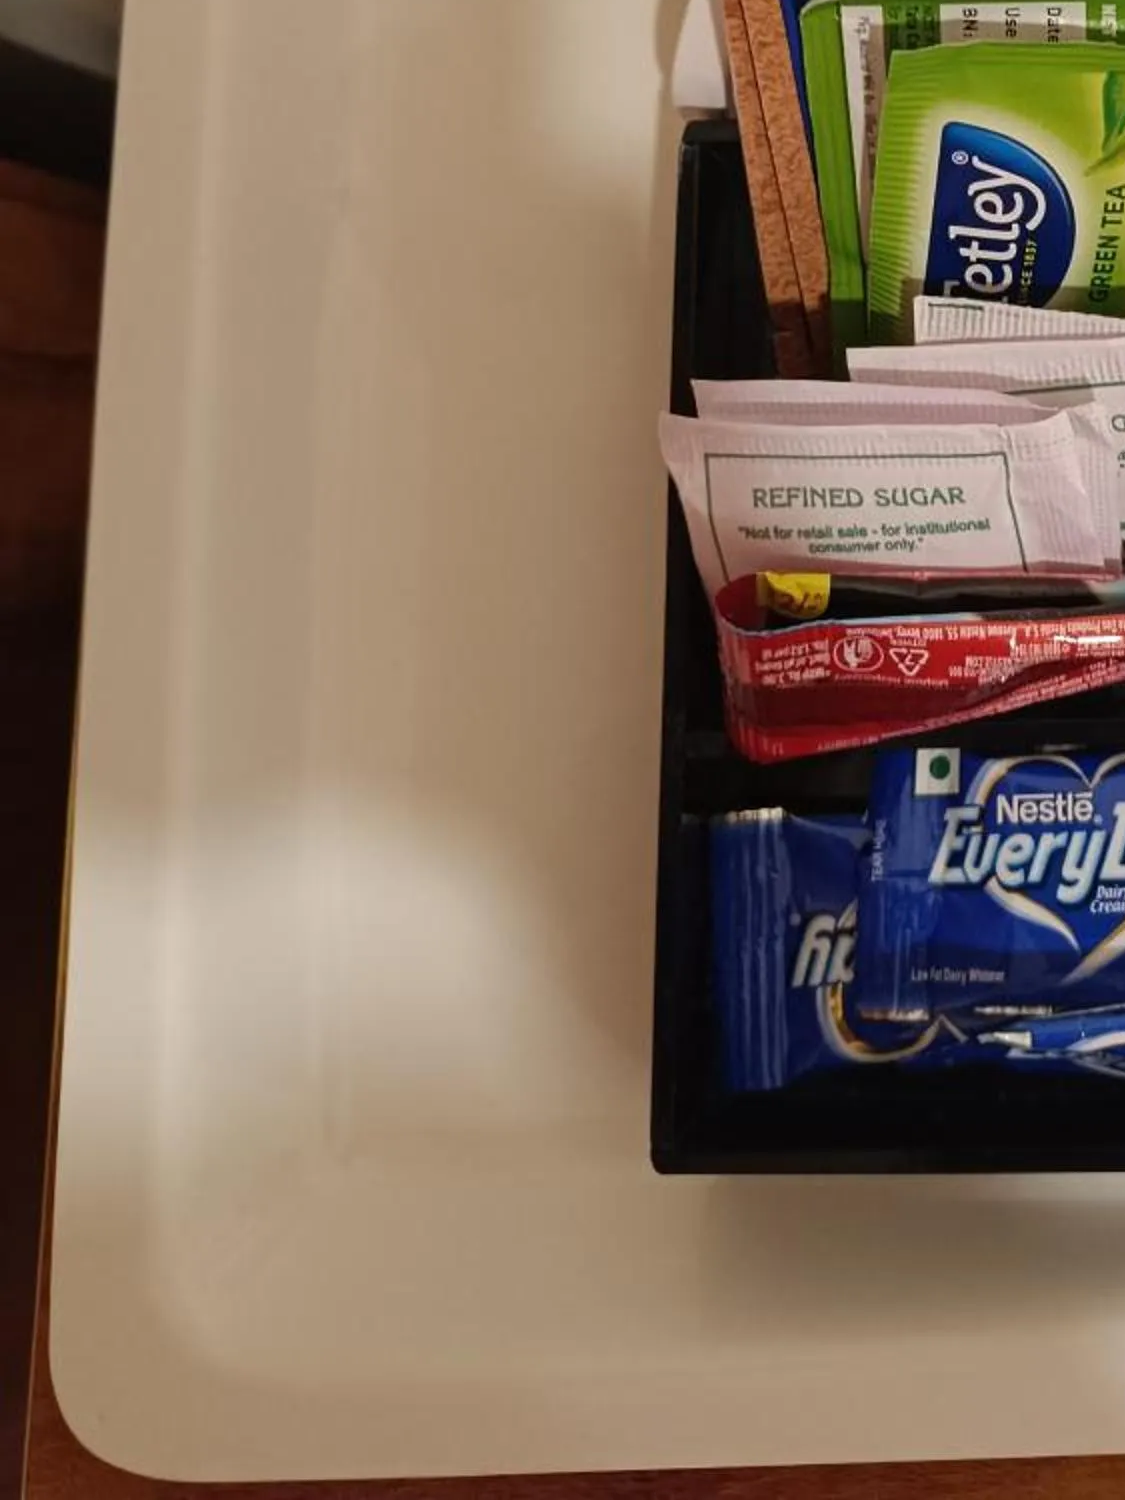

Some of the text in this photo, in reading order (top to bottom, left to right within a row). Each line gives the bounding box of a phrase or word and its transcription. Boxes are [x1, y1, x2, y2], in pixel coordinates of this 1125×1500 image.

[1005, 7, 1020, 37] Use
[1089, 235, 1120, 302] GREEN
[752, 485, 966, 509] REFINED SUGAR
[774, 526, 792, 540] for
[797, 525, 832, 540] retail
[837, 525, 867, 539] sale
[881, 523, 900, 536] for
[905, 518, 990, 536] institutional
[808, 540, 880, 554] consumer
